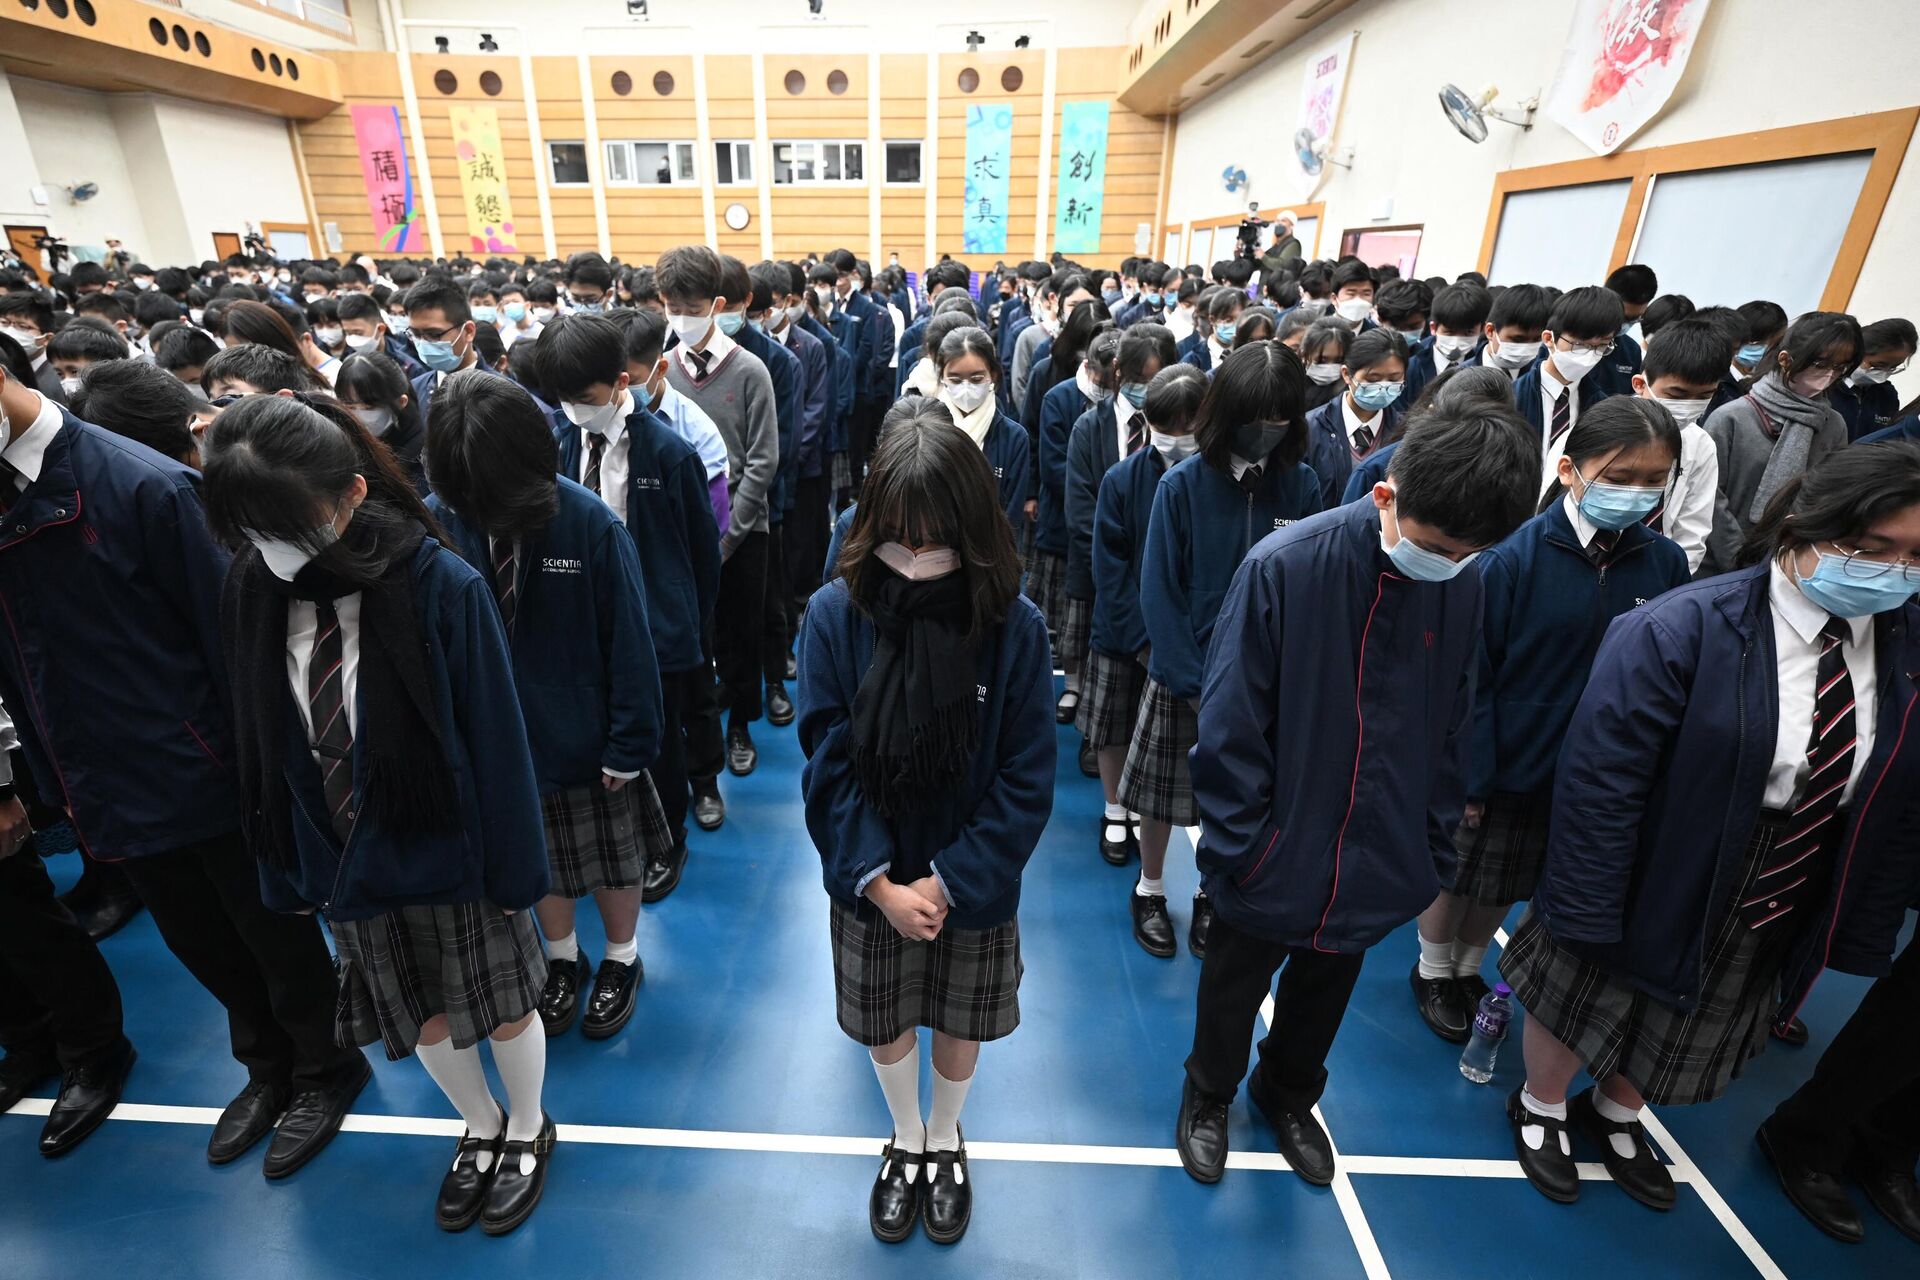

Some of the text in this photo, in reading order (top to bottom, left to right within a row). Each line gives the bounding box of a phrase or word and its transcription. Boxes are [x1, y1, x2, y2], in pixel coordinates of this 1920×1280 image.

[371, 150, 408, 225] 積極
[467, 152, 501, 224] 誠懇
[972, 152, 1001, 224] 求真
[1064, 150, 1097, 226] 創新
[543, 557, 582, 568] SCIENTIA
